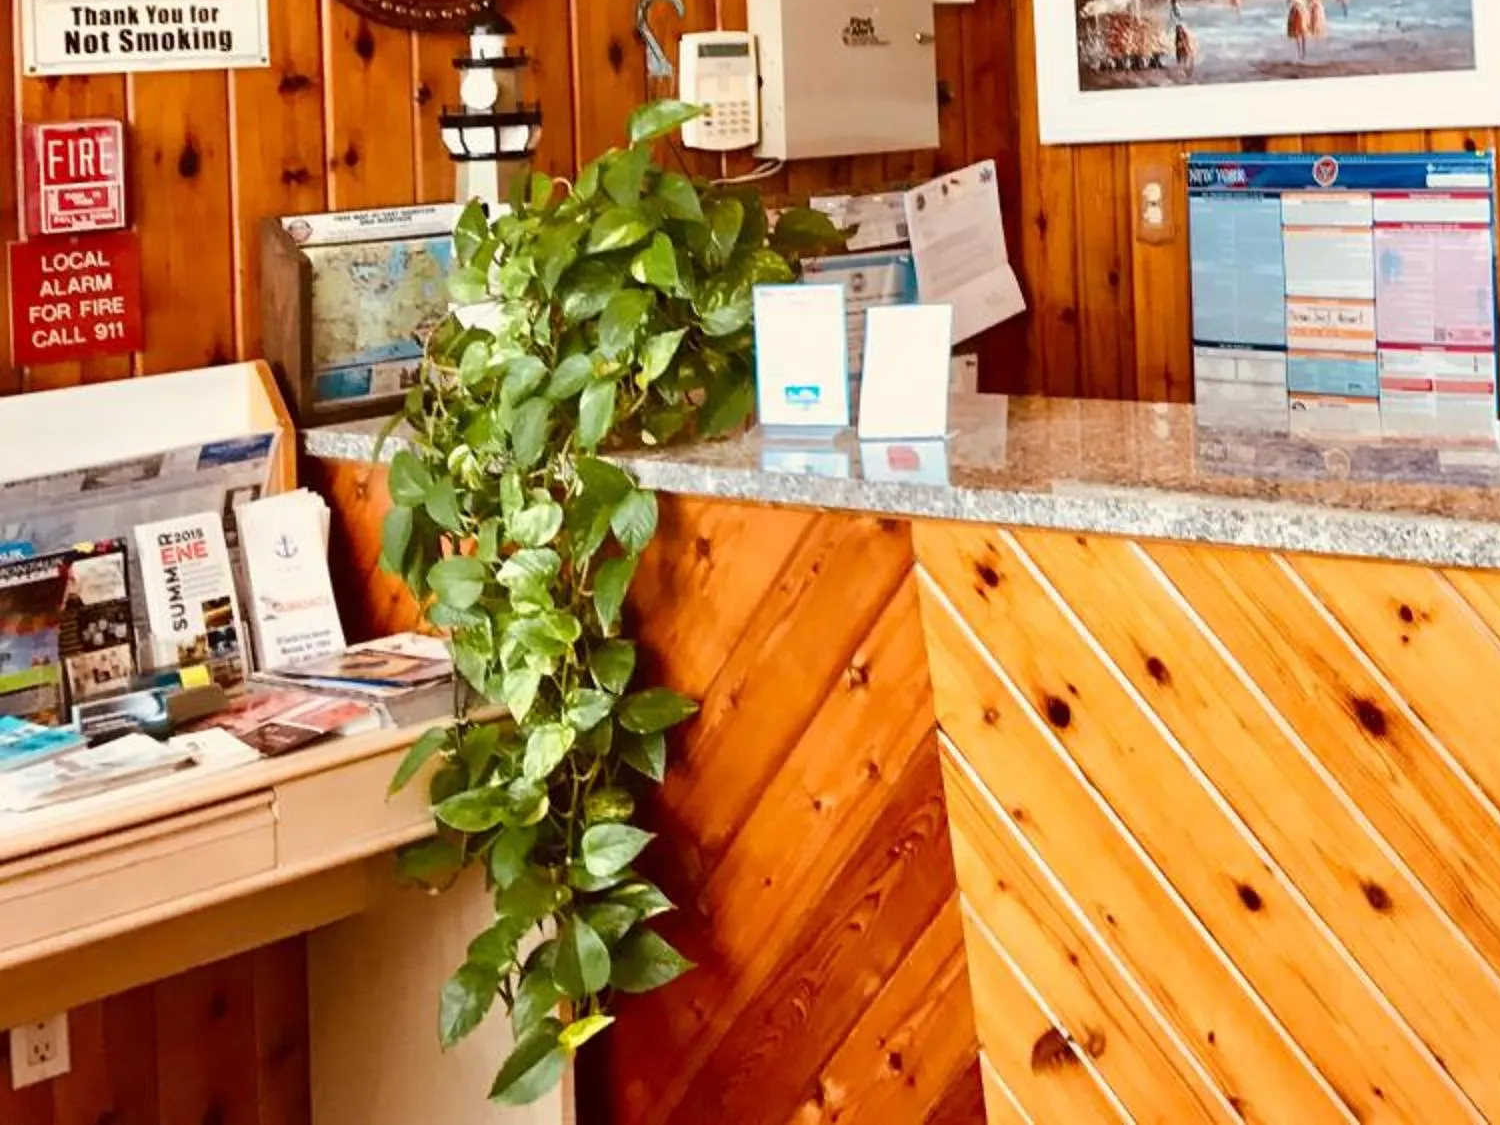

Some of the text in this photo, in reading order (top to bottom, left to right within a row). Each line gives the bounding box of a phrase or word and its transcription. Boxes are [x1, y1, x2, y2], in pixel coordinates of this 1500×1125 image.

[71, 5, 219, 26] Thank You for
[64, 27, 233, 54] Not Smoking
[48, 137, 114, 179] FIRE
[41, 251, 110, 273] LOCAL
[40, 273, 113, 297] ALARM
[29, 297, 125, 323] FOR FIRE
[32, 322, 125, 348] CALL 911
